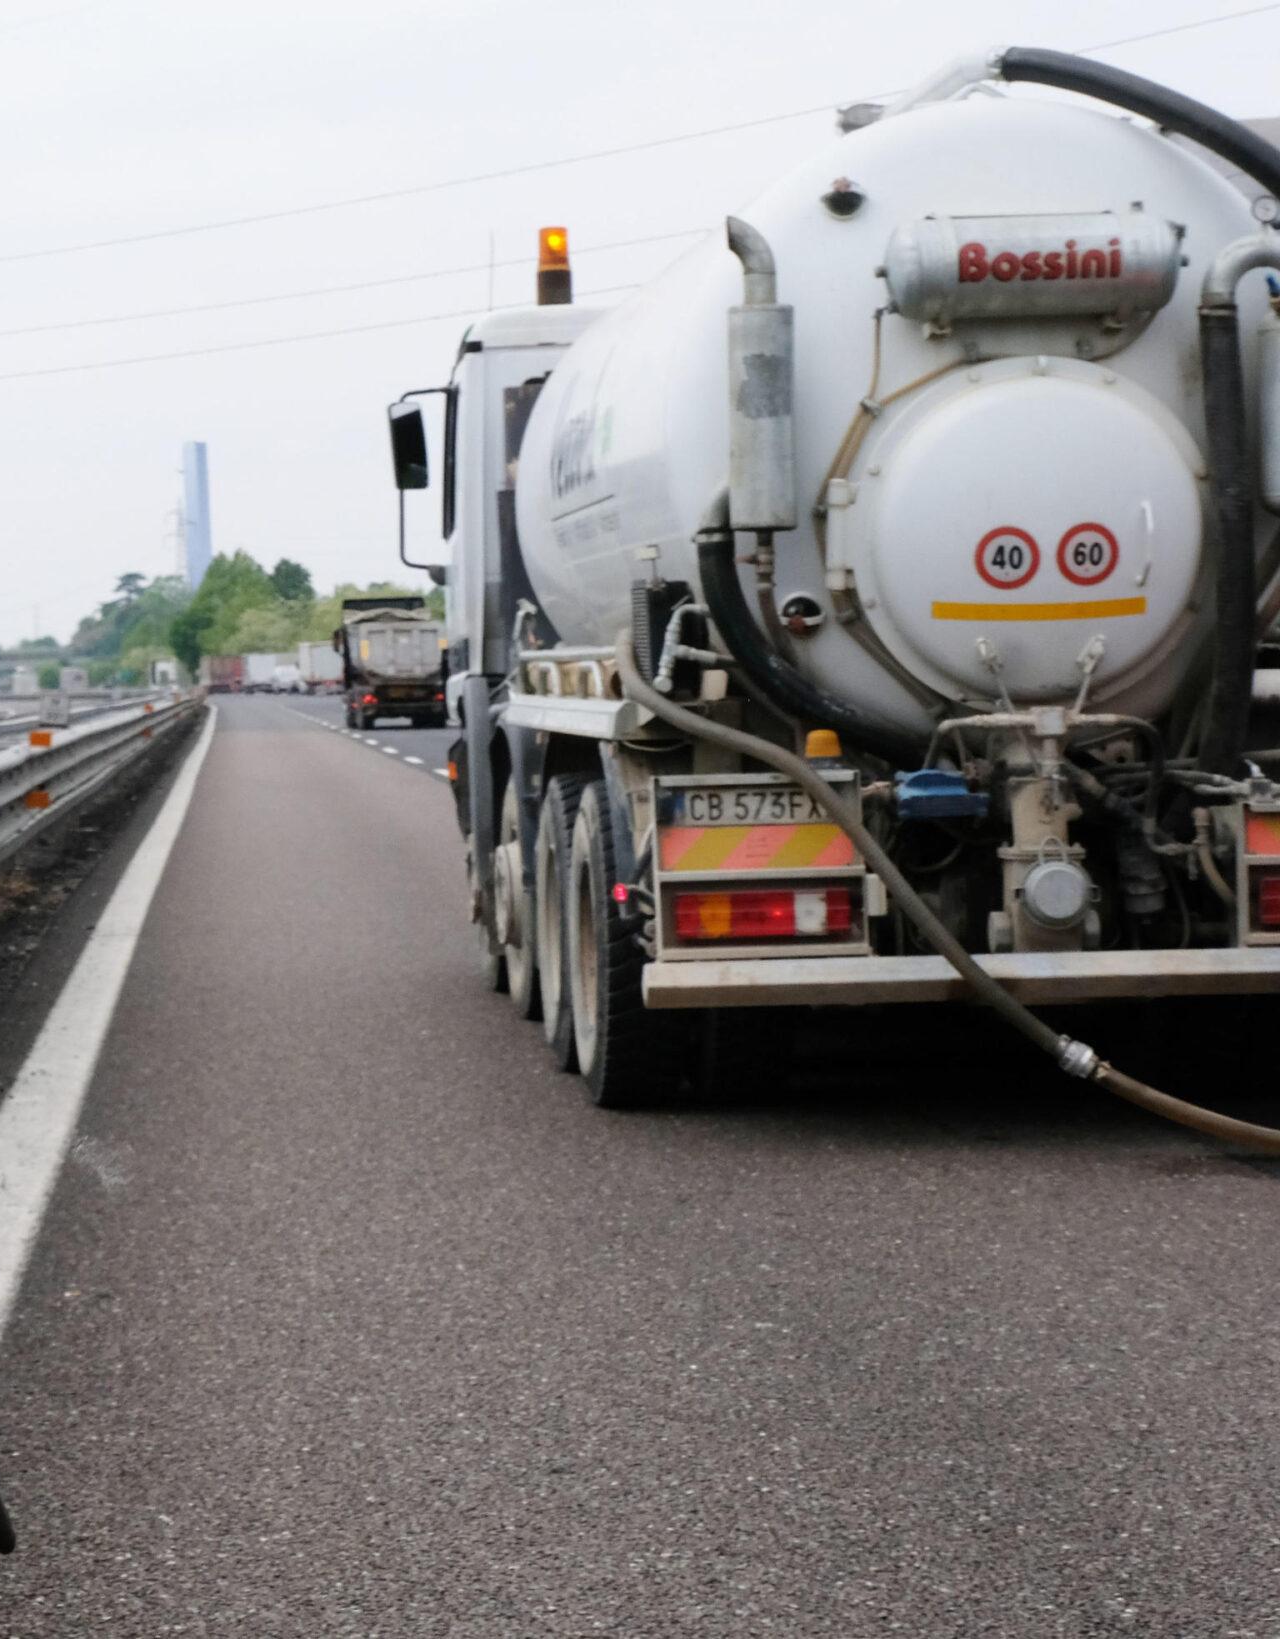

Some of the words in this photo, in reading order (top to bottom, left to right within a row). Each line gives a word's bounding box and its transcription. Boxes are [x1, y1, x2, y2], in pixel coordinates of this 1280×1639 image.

[959, 237, 1121, 283] Bossini
[992, 545, 1023, 569] 40
[1073, 542, 1103, 566] 60
[689, 793, 723, 821] CB
